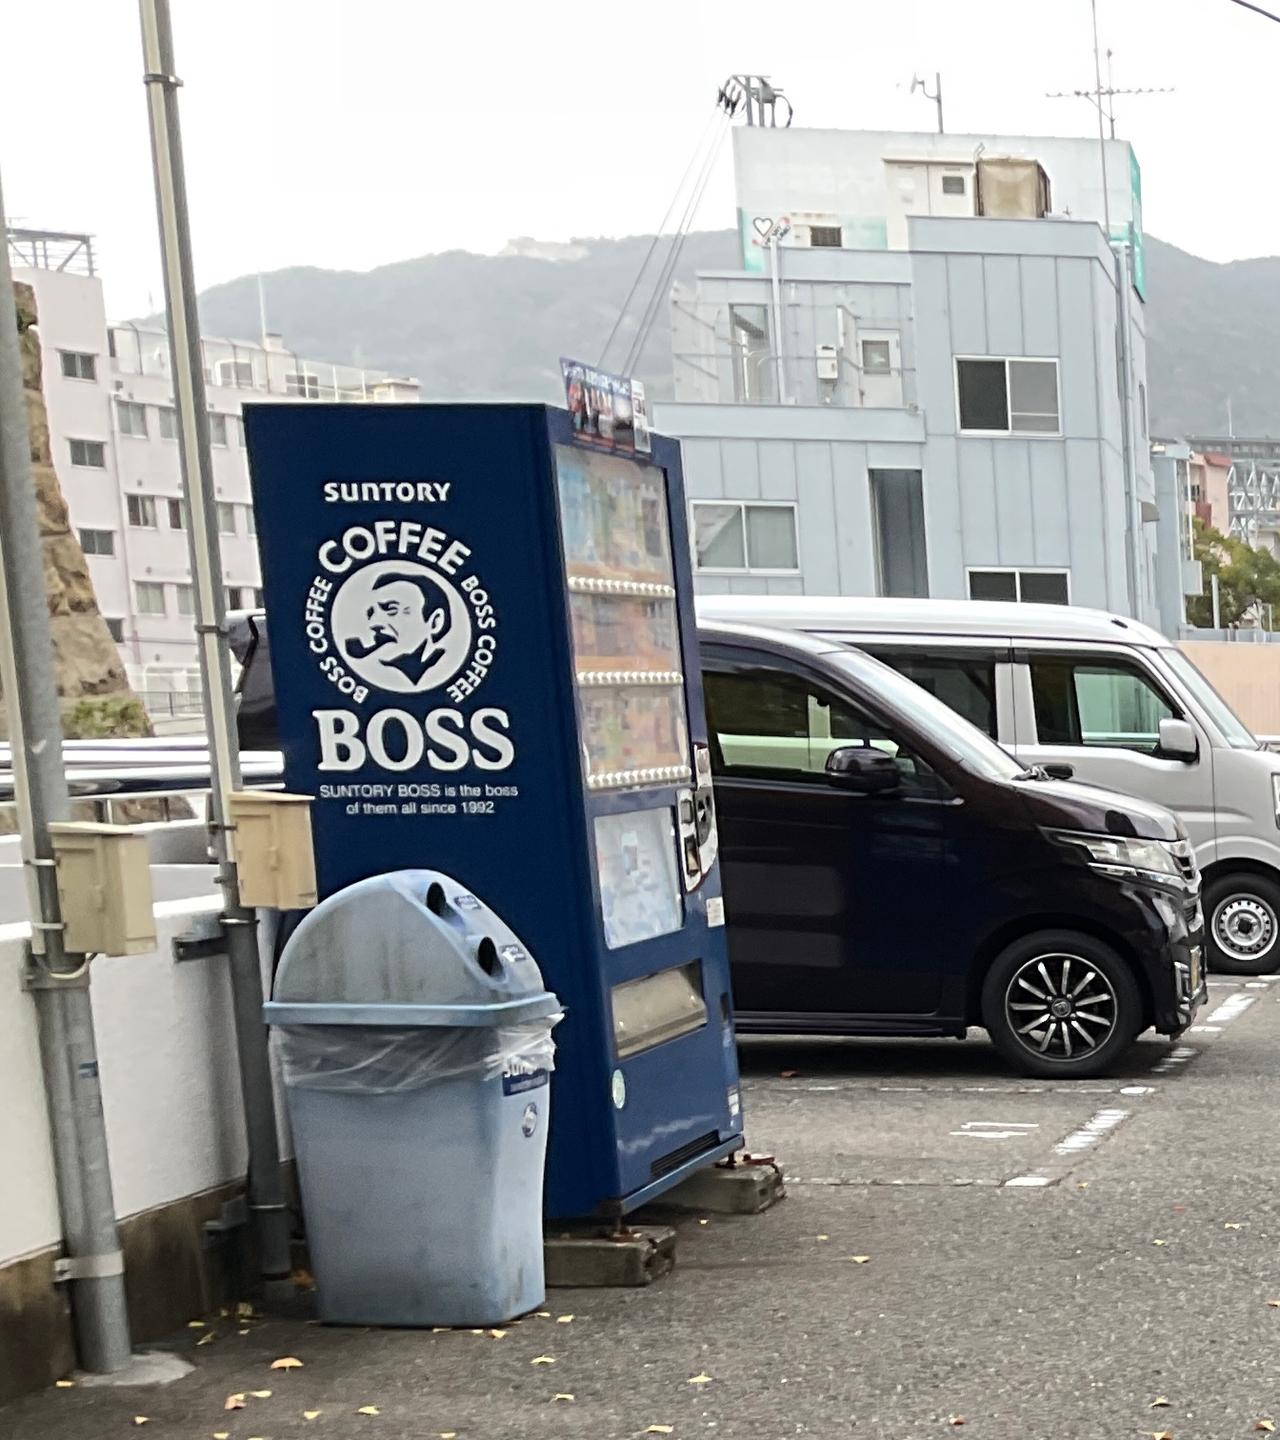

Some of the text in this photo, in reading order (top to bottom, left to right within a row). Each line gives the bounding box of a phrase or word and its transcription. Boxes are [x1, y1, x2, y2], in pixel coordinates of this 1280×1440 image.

[323, 481, 451, 502] SUNTORY
[318, 519, 472, 576] COFFEE
[304, 575, 369, 704] BOSS COFFEE
[446, 575, 497, 703] BOSS COFFEE
[312, 707, 515, 772] BOSS
[319, 784, 519, 798] SUNTORY BOSS is the boss
[346, 801, 495, 815] of them all since 1992
